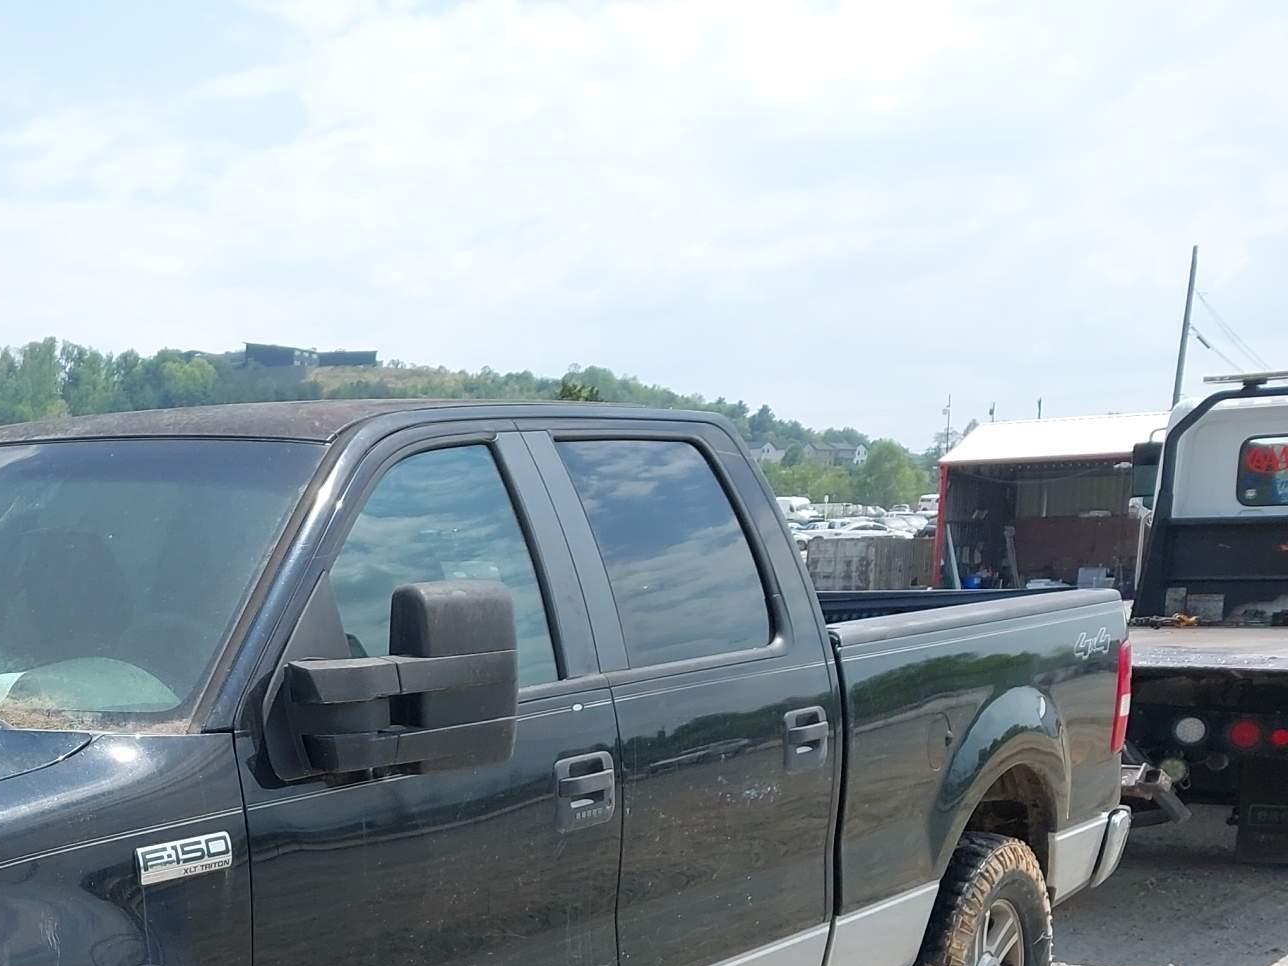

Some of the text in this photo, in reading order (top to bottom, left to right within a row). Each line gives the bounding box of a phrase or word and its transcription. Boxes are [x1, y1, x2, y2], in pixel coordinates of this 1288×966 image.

[1074, 626, 1111, 660] 4x4
[183, 859, 230, 875] XLT TRITON
